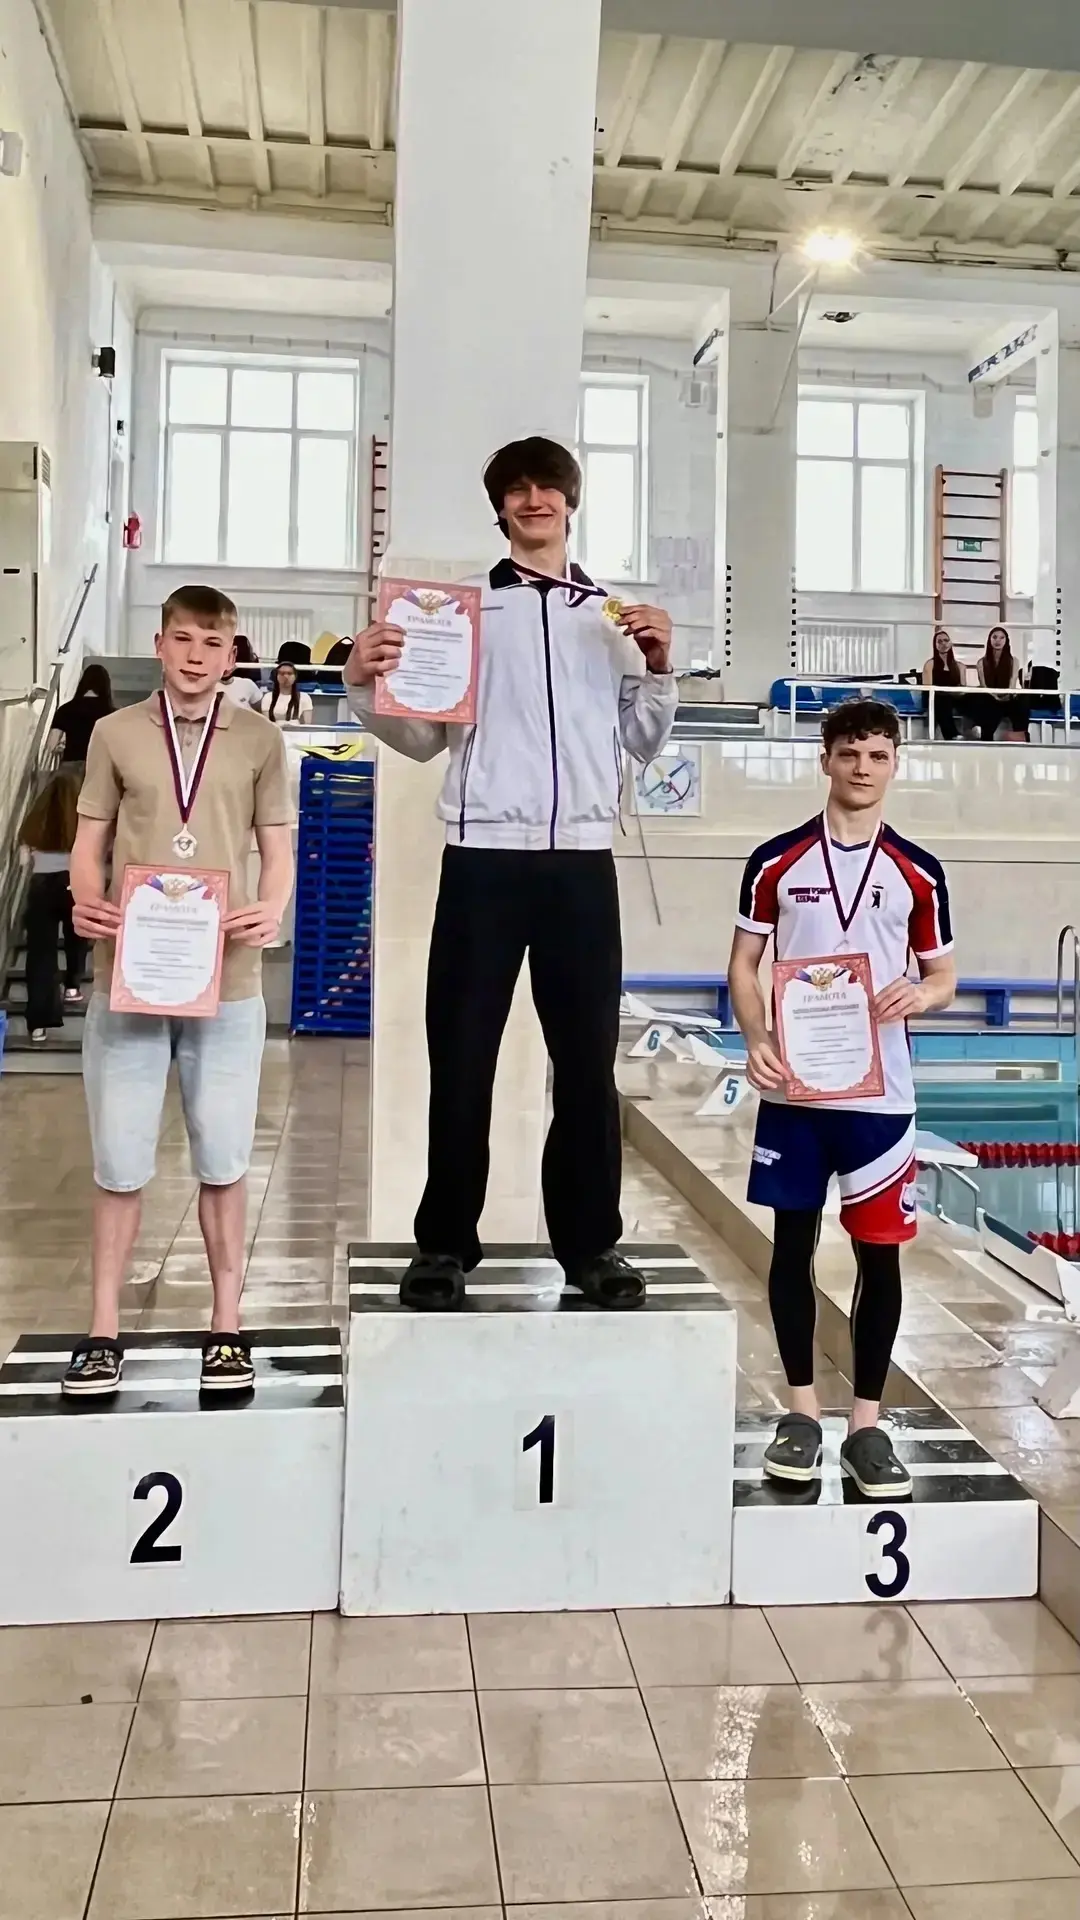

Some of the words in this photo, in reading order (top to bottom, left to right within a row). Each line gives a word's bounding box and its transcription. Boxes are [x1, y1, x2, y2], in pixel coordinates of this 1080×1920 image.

[647, 1029, 660, 1051] 6
[724, 1078, 739, 1104] 5
[523, 1415, 555, 1503] 1
[129, 1471, 183, 1563] 2
[865, 1510, 910, 1598] 3
